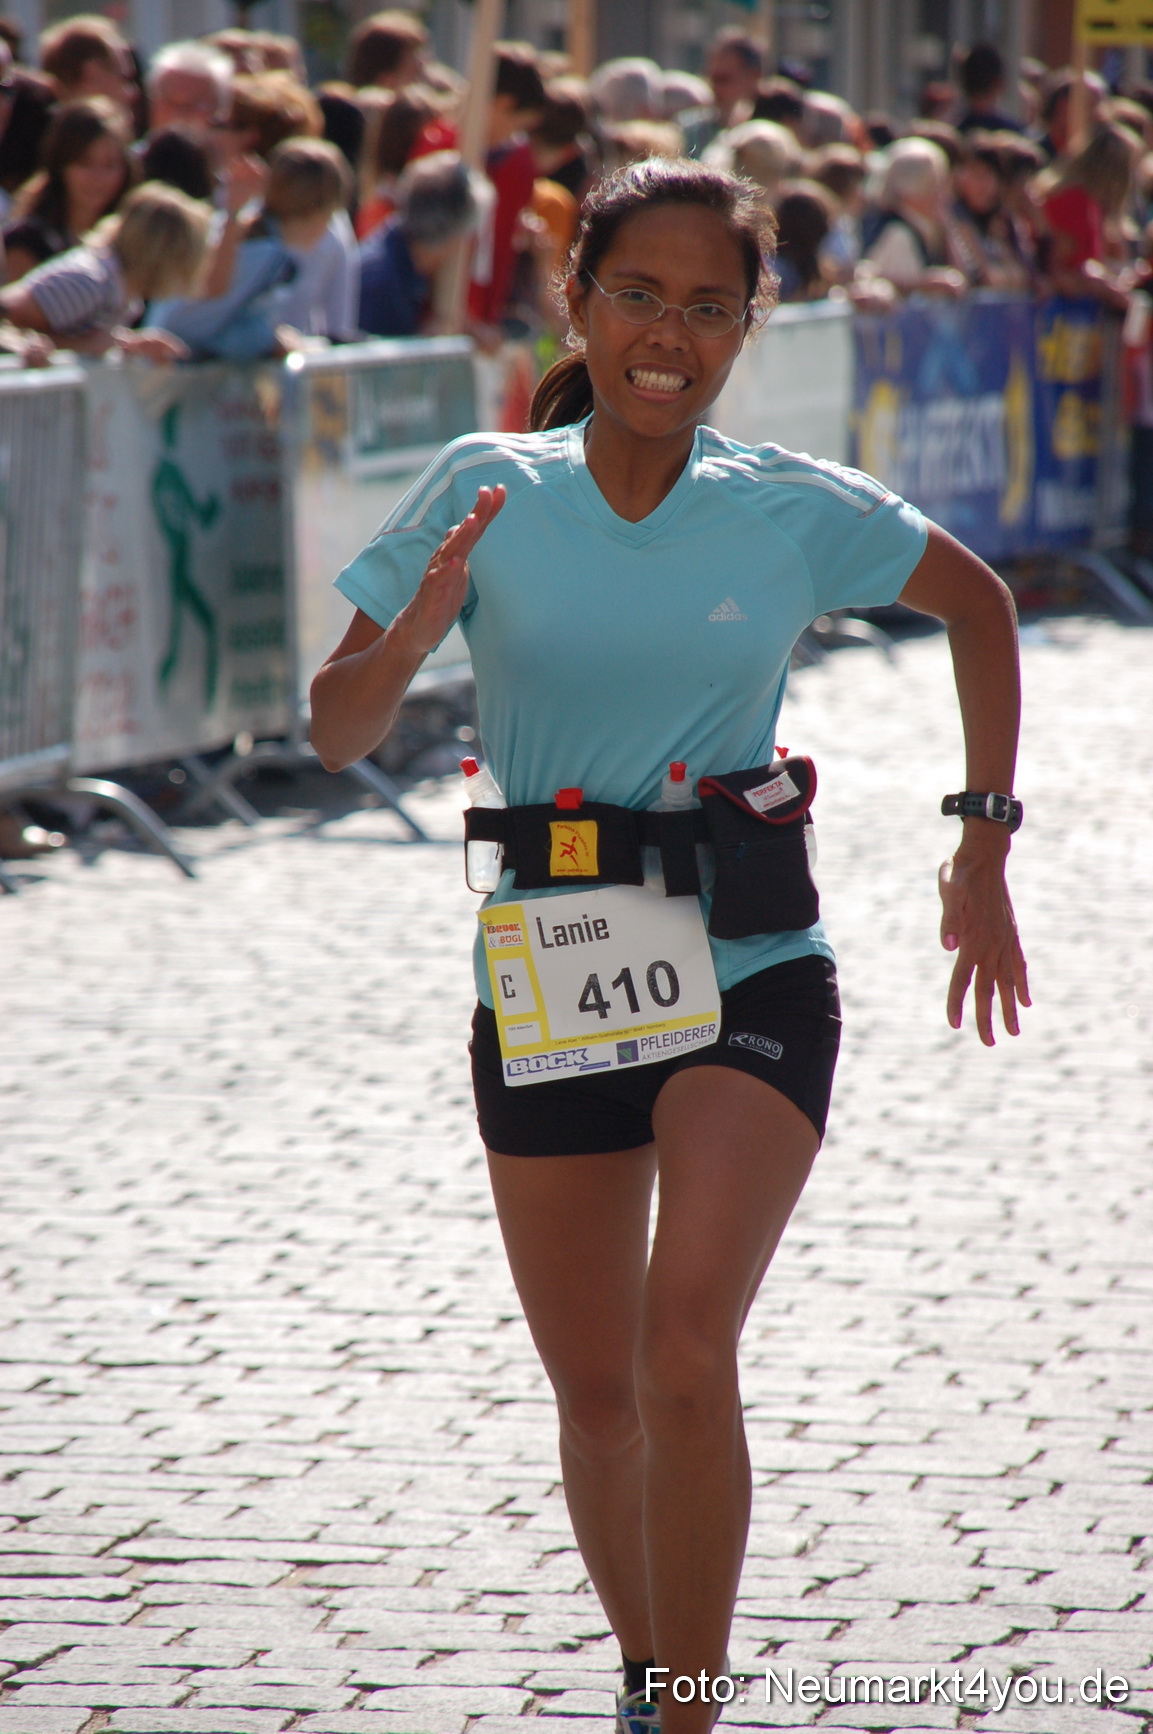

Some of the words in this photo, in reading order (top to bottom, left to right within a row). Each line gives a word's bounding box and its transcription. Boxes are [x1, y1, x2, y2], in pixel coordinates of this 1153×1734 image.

[708, 611, 748, 621] adidas
[752, 780, 784, 798] PERFEKTA
[488, 937, 497, 949] &
[535, 914, 610, 949] Lanie
[501, 974, 517, 999] C
[577, 960, 680, 1020] 410
[640, 1023, 717, 1052] PFLEIDERER
[641, 1036, 716, 1062] AKTIENGESELLSCHAFT
[506, 1049, 589, 1077] BOCK
